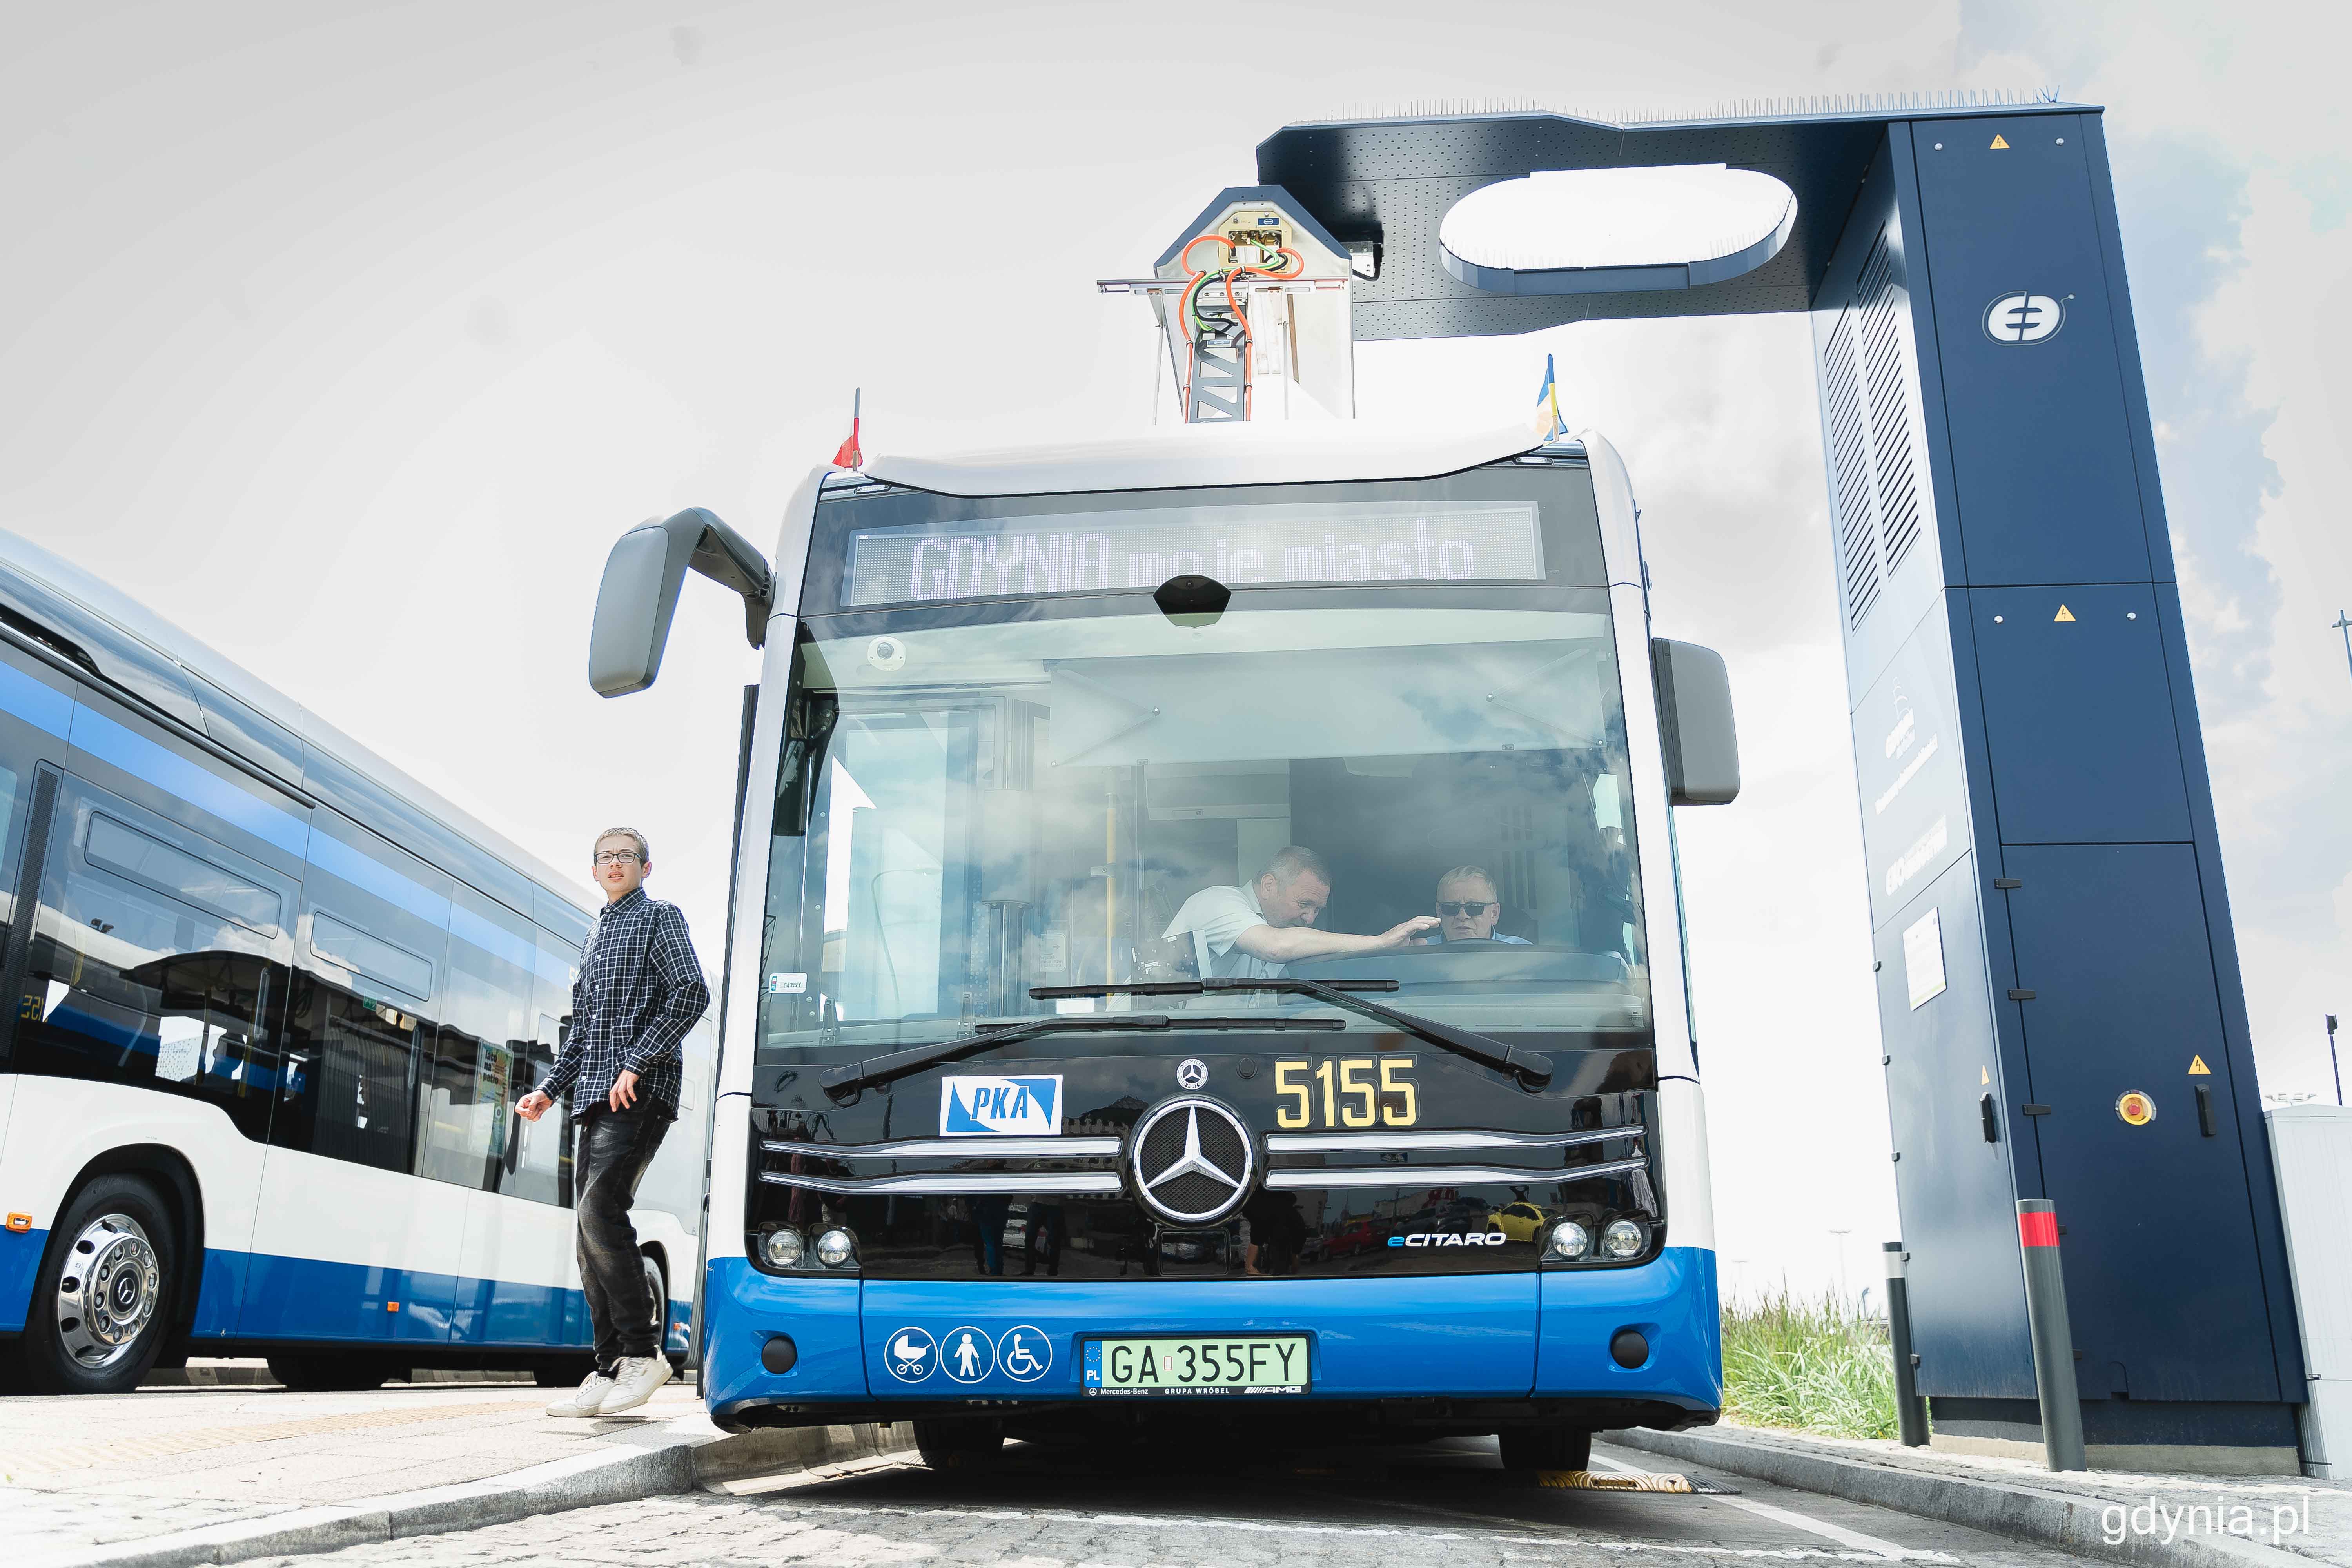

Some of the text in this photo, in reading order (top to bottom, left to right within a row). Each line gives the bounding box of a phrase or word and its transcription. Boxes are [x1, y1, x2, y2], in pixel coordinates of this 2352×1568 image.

[911, 533, 1109, 601] GDYNIA
[1285, 519, 1475, 581] miasto
[485, 1049, 497, 1062] lato
[484, 1062, 492, 1071] na
[483, 1073, 499, 1085] patio
[1275, 1057, 1417, 1128] 5155
[971, 1087, 1028, 1119] PKA
[1387, 1232, 1507, 1247] eCITARO
[1111, 1343, 1296, 1383] GA 355FY
[1087, 1370, 1100, 1381] PL
[1195, 1386, 1230, 1394] WRÓBEL
